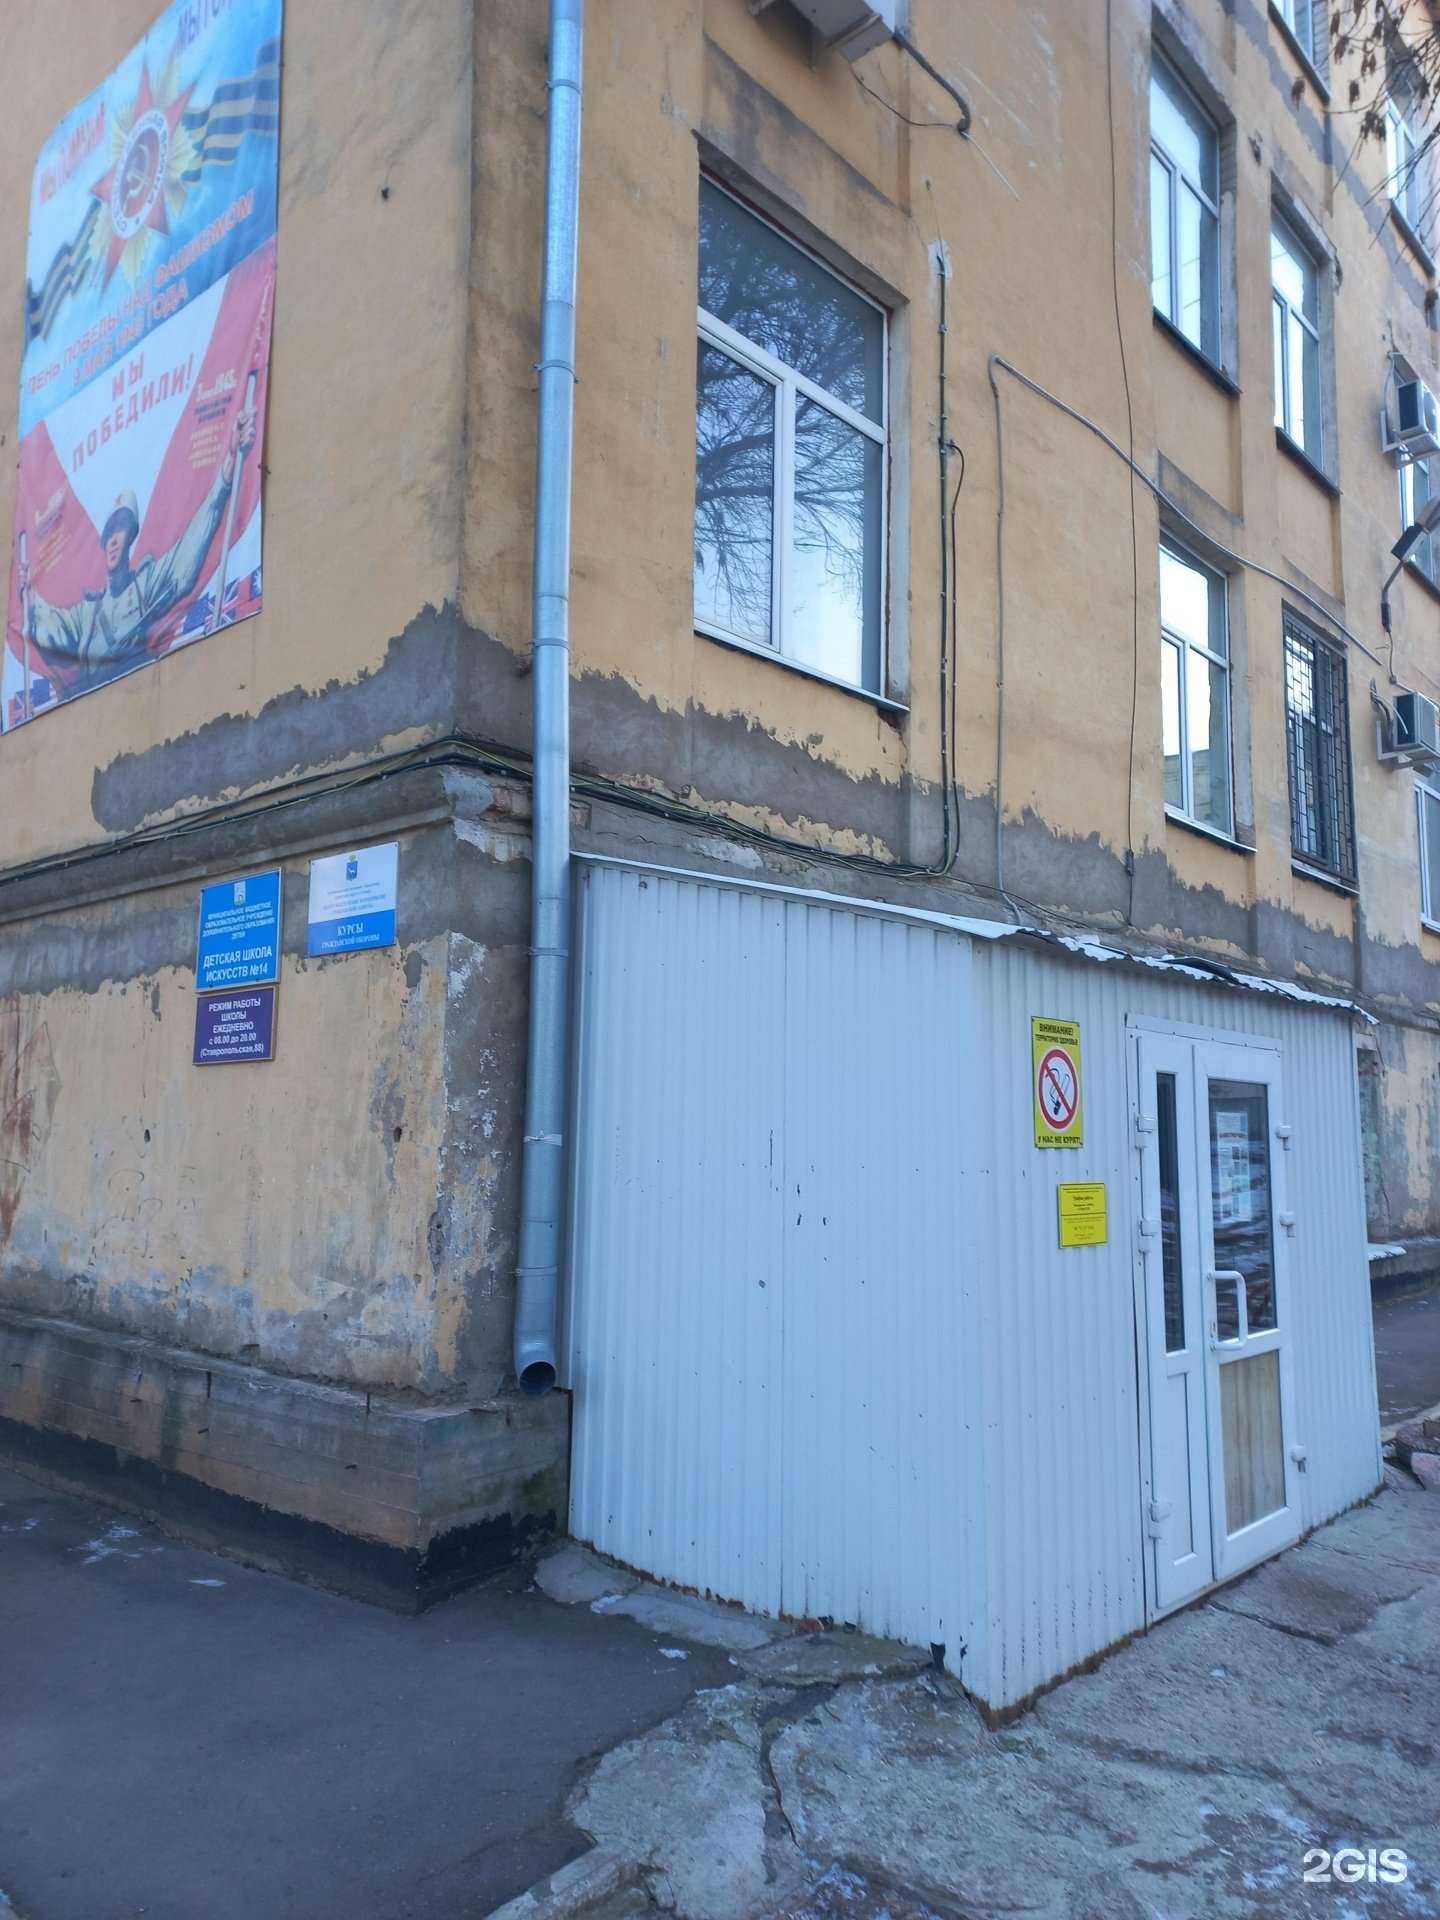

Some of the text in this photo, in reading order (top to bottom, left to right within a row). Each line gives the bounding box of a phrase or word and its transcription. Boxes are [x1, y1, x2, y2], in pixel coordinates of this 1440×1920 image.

[112, 352, 145, 401] МЫ
[72, 352, 194, 473] ПОБЕДИЛИ!
[337, 922, 364, 937] КУРСЫ
[203, 945, 272, 968] ДЕТСКАЯ ШКОЛА
[206, 963, 268, 982] ИСКУССТВ №14
[208, 997, 261, 1012] РЕЖИМ РАБОТЫ
[221, 1010, 247, 1021] ШКОЛЫ
[213, 1021, 254, 1033] ЕЖЕДНЕВНО
[1039, 1023, 1073, 1036] ВНИМАНИЕ!
[1042, 1135, 1054, 1144] НАС
